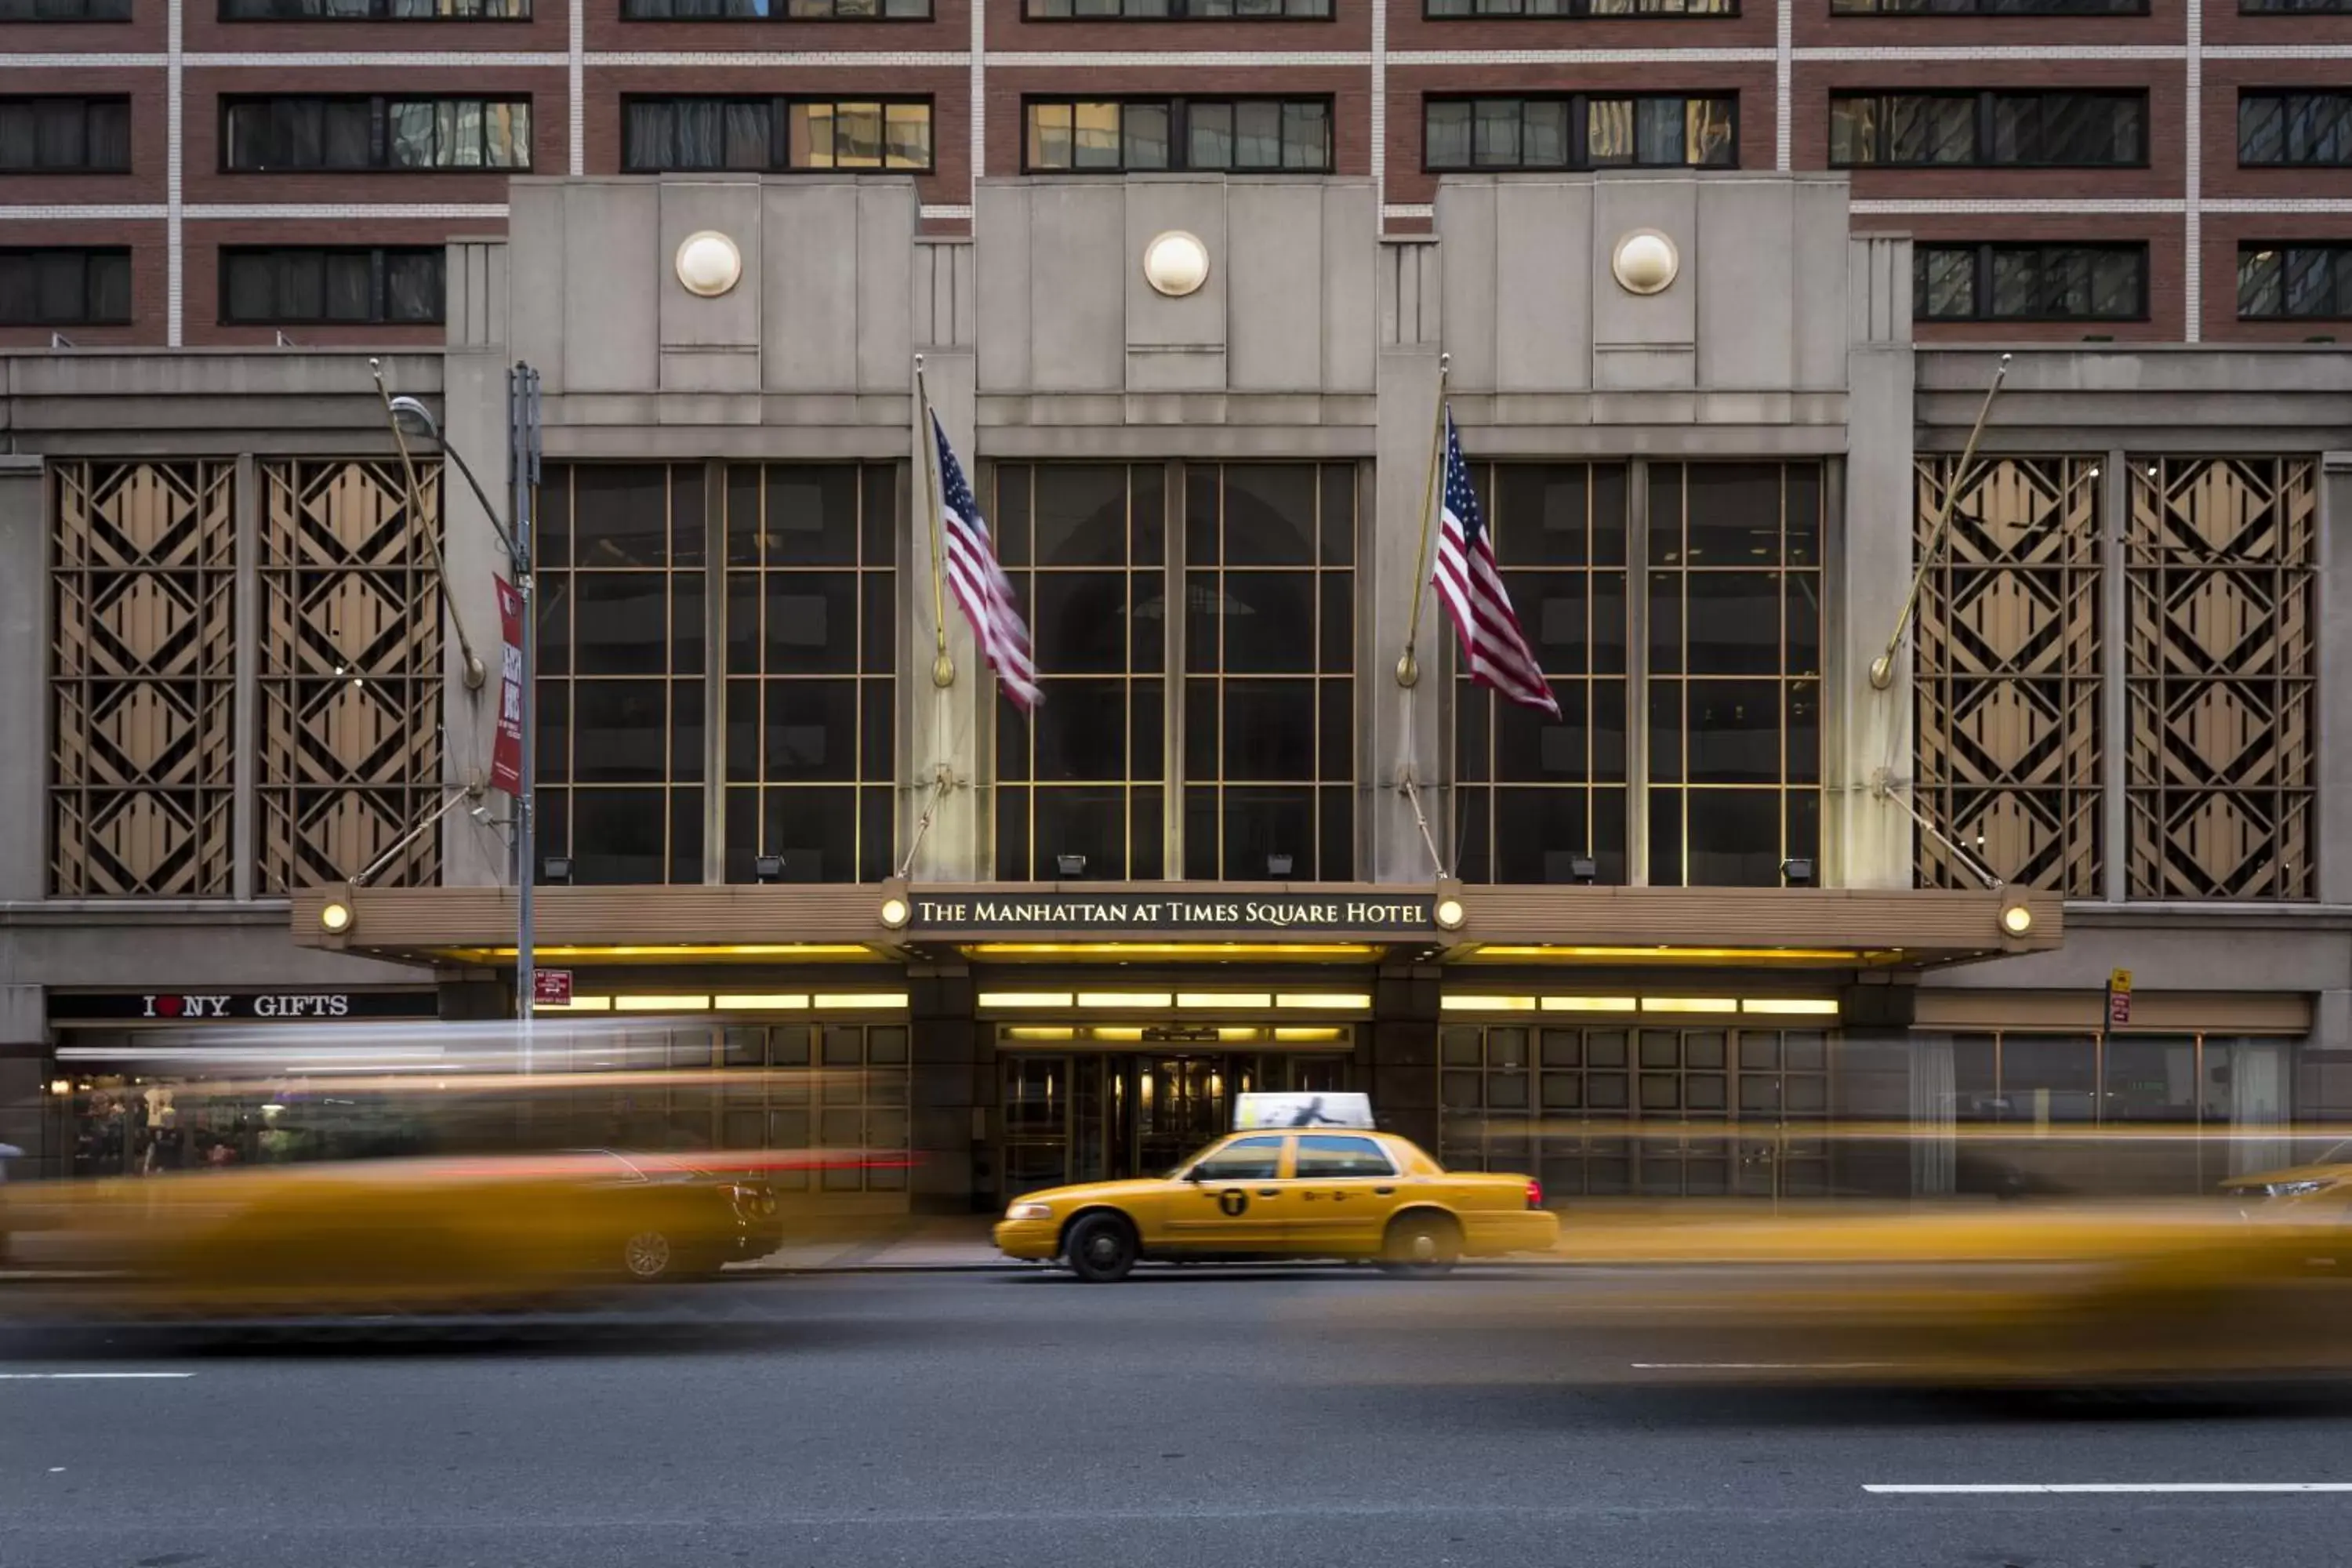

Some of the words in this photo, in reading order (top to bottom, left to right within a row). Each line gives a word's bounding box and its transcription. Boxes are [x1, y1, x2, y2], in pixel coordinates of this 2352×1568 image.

[919, 902, 967, 921] THE
[974, 902, 1127, 921] MANHATTAN
[1167, 902, 1238, 921] TIMES
[1246, 902, 1338, 926] SQUARE
[1346, 903, 1427, 922] HOTEL
[143, 995, 156, 1017] I
[254, 995, 348, 1017] GIFTS
